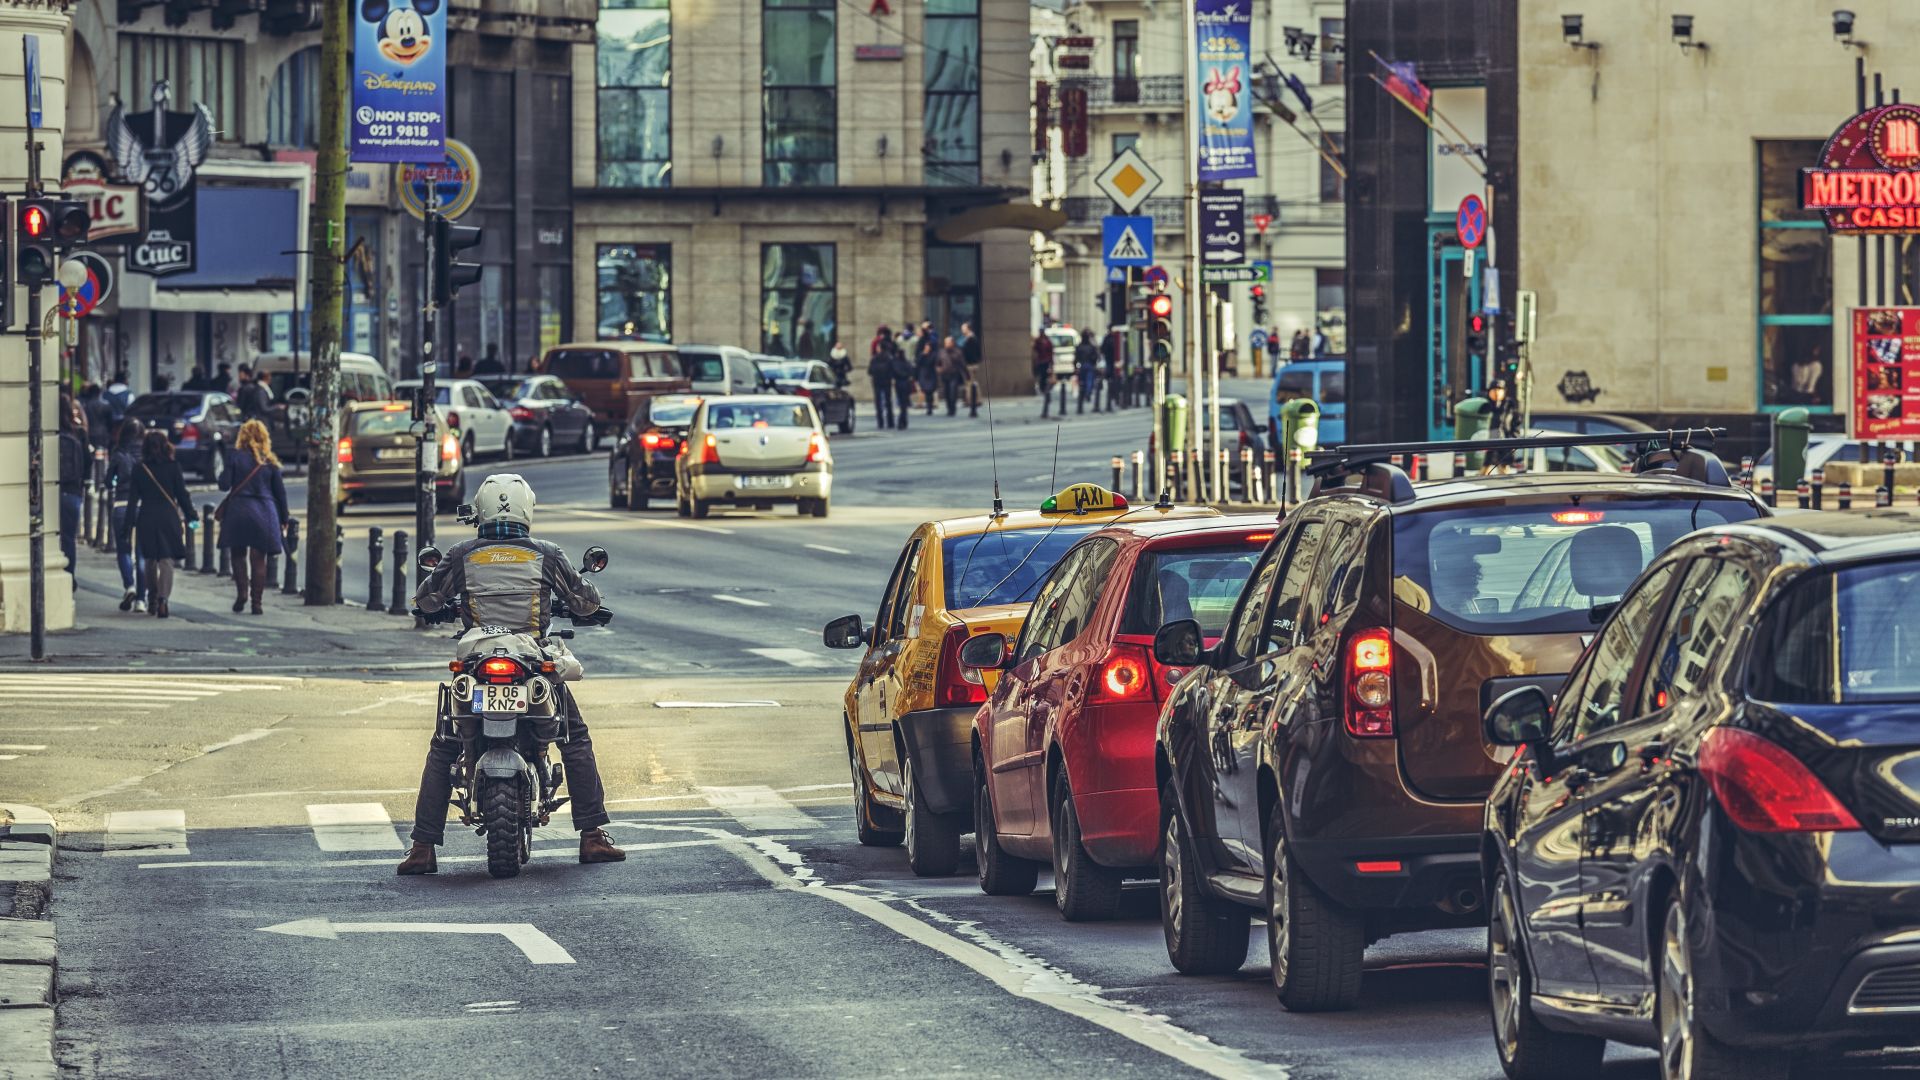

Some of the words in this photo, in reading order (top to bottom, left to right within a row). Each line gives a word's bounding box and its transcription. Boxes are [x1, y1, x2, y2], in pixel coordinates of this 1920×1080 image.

[375, 110, 405, 122] NON
[407, 112, 441, 123] STOP:
[369, 124, 392, 137] 021
[396, 125, 429, 137] 9818
[145, 166, 175, 194] 66
[135, 245, 183, 266] Ciuc
[1071, 487, 1104, 507] TAXI
[487, 686, 497, 698] B
[502, 686, 519, 698] 06
[473, 701, 482, 709] RO
[488, 699, 516, 711] KNZ
